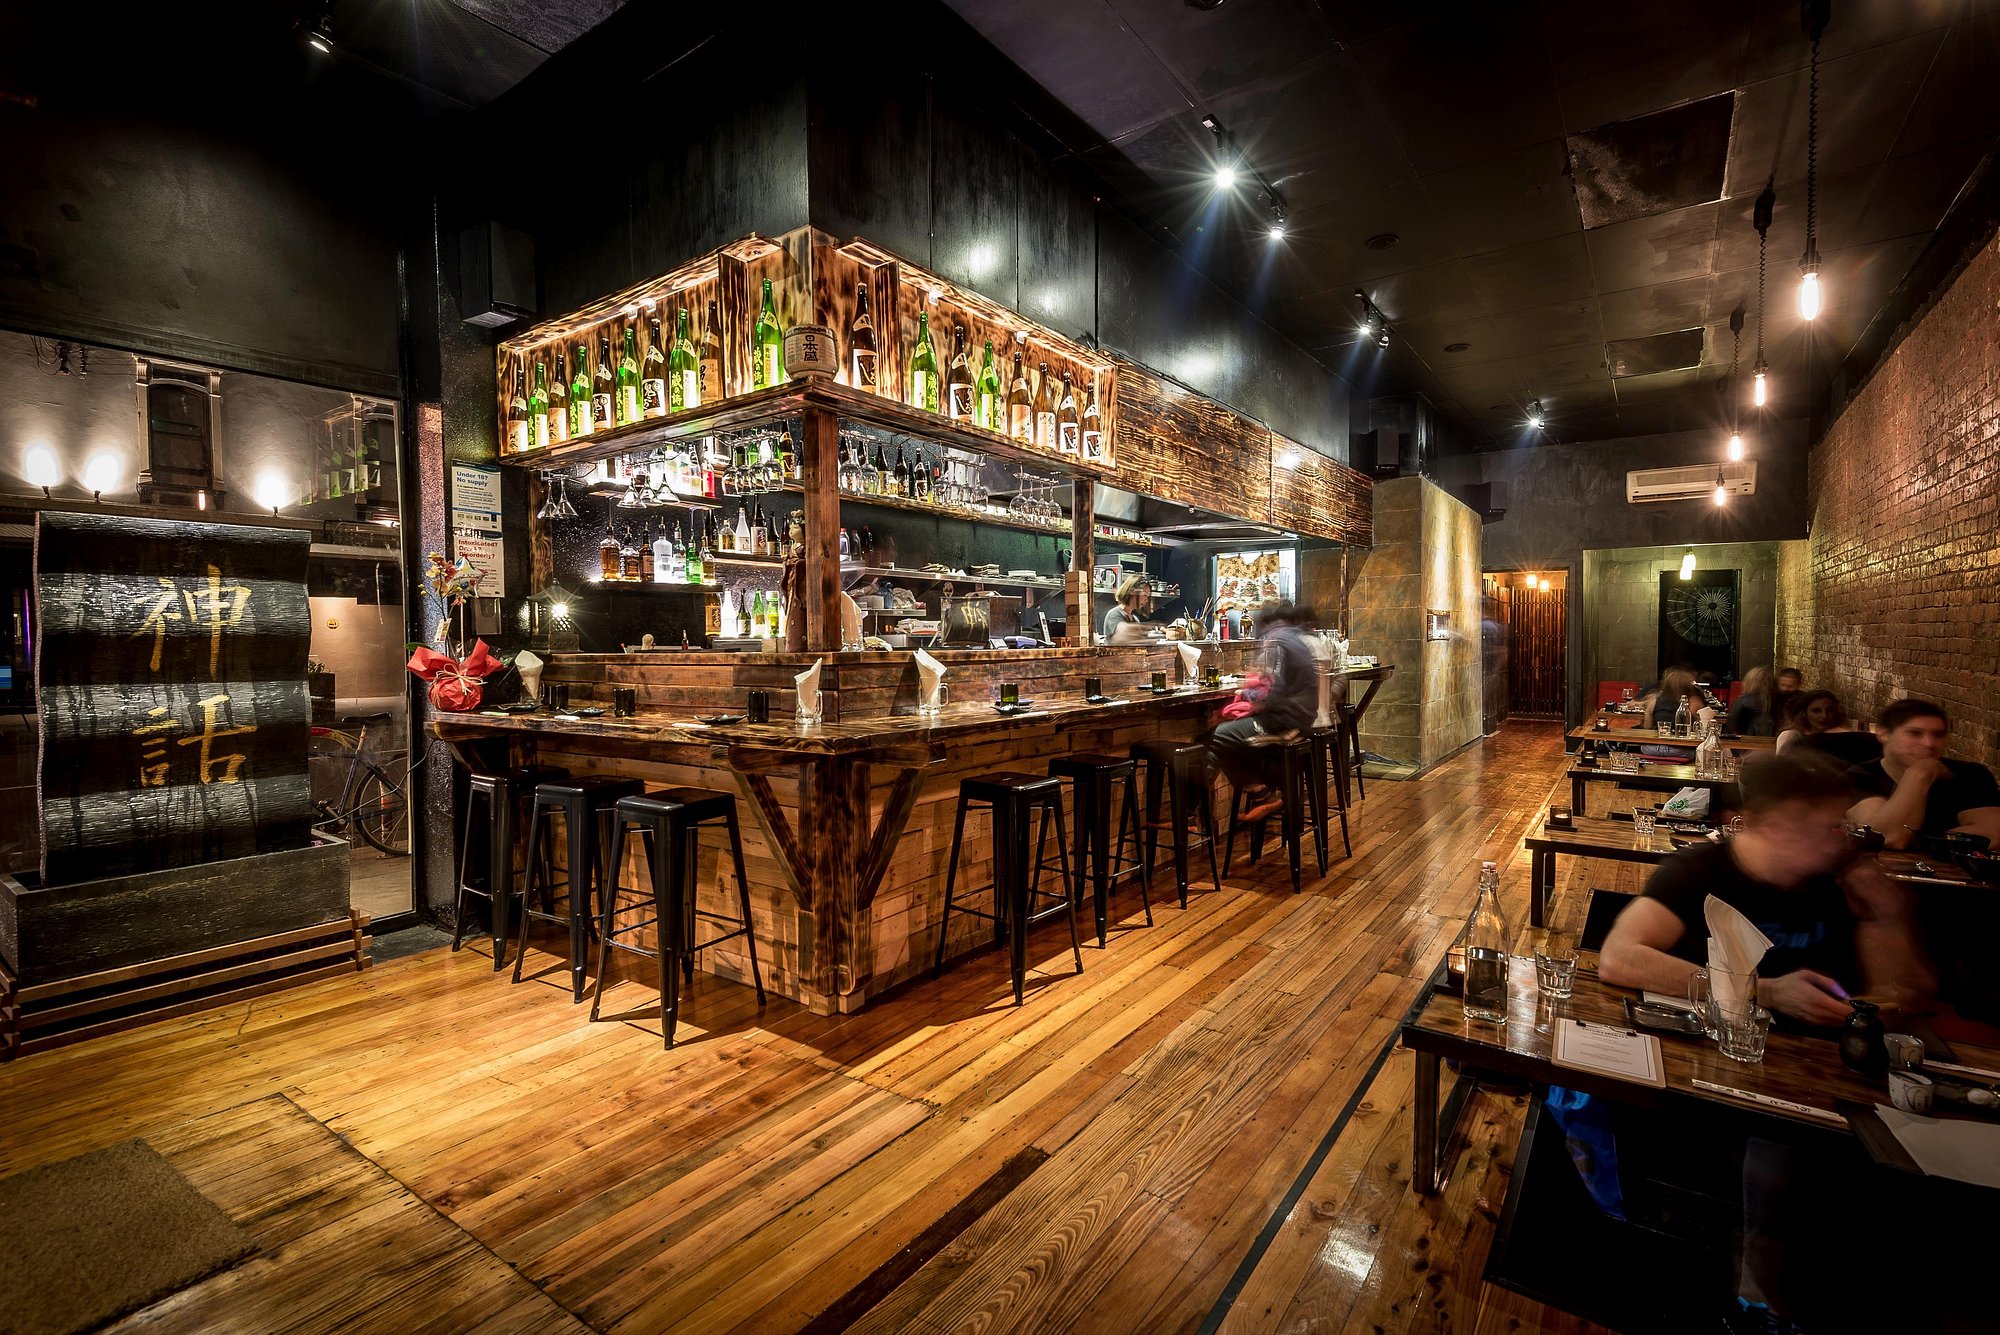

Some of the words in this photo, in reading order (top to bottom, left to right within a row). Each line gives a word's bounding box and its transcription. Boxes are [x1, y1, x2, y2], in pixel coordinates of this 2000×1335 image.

[802, 334, 819, 362] 日本盛
[456, 471, 476, 479] Under
[467, 479, 489, 487] supply
[458, 539, 499, 548] Intoxicated?
[131, 563, 258, 786] 神話
